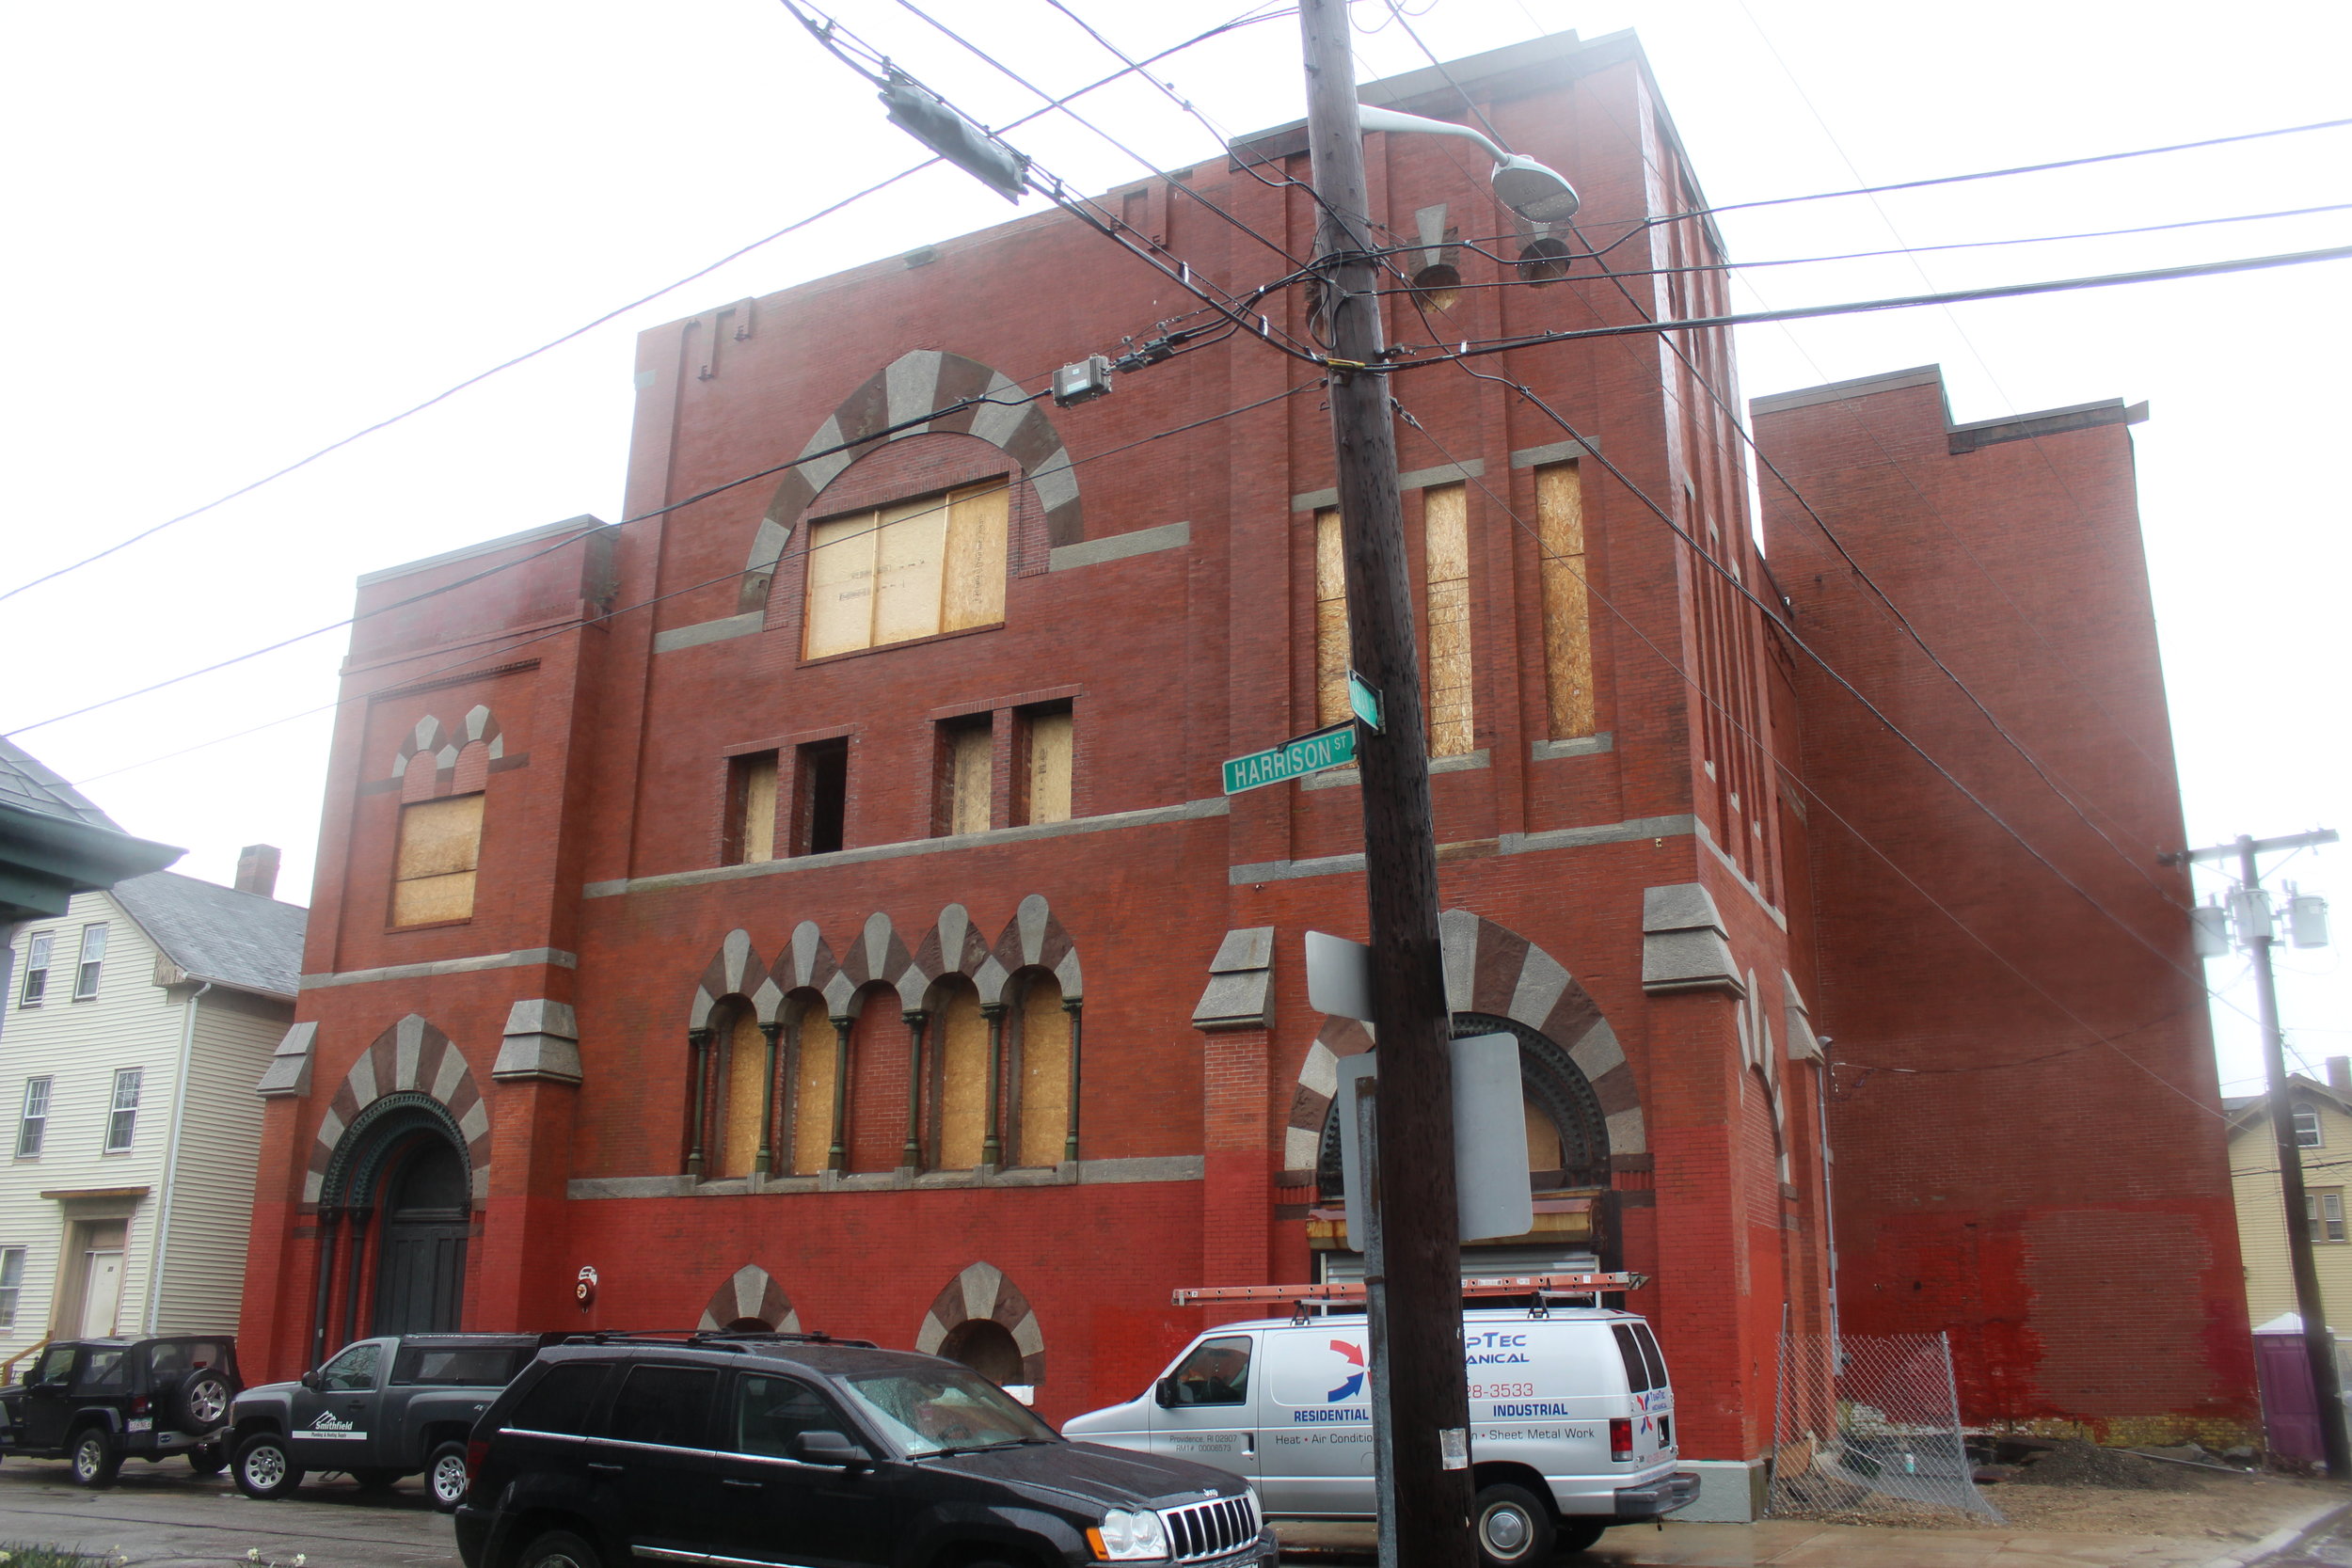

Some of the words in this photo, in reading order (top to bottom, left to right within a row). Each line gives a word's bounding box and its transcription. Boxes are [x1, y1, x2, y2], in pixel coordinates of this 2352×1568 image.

[1234, 740, 1331, 787] HARRISON
[1334, 736, 1346, 750] ST
[1294, 1408, 1369, 1422] RESIDENTIAL
[1493, 1403, 1568, 1417] INDUSTRIAL
[315, 1420, 353, 1430] Smithfield
[1276, 1434, 1300, 1445] Heat
[1311, 1433, 1327, 1444] Air
[1330, 1433, 1373, 1444] Conditio
[1489, 1429, 1523, 1440] Sheet
[1527, 1428, 1561, 1440] Metal
[1565, 1427, 1596, 1439] Work
